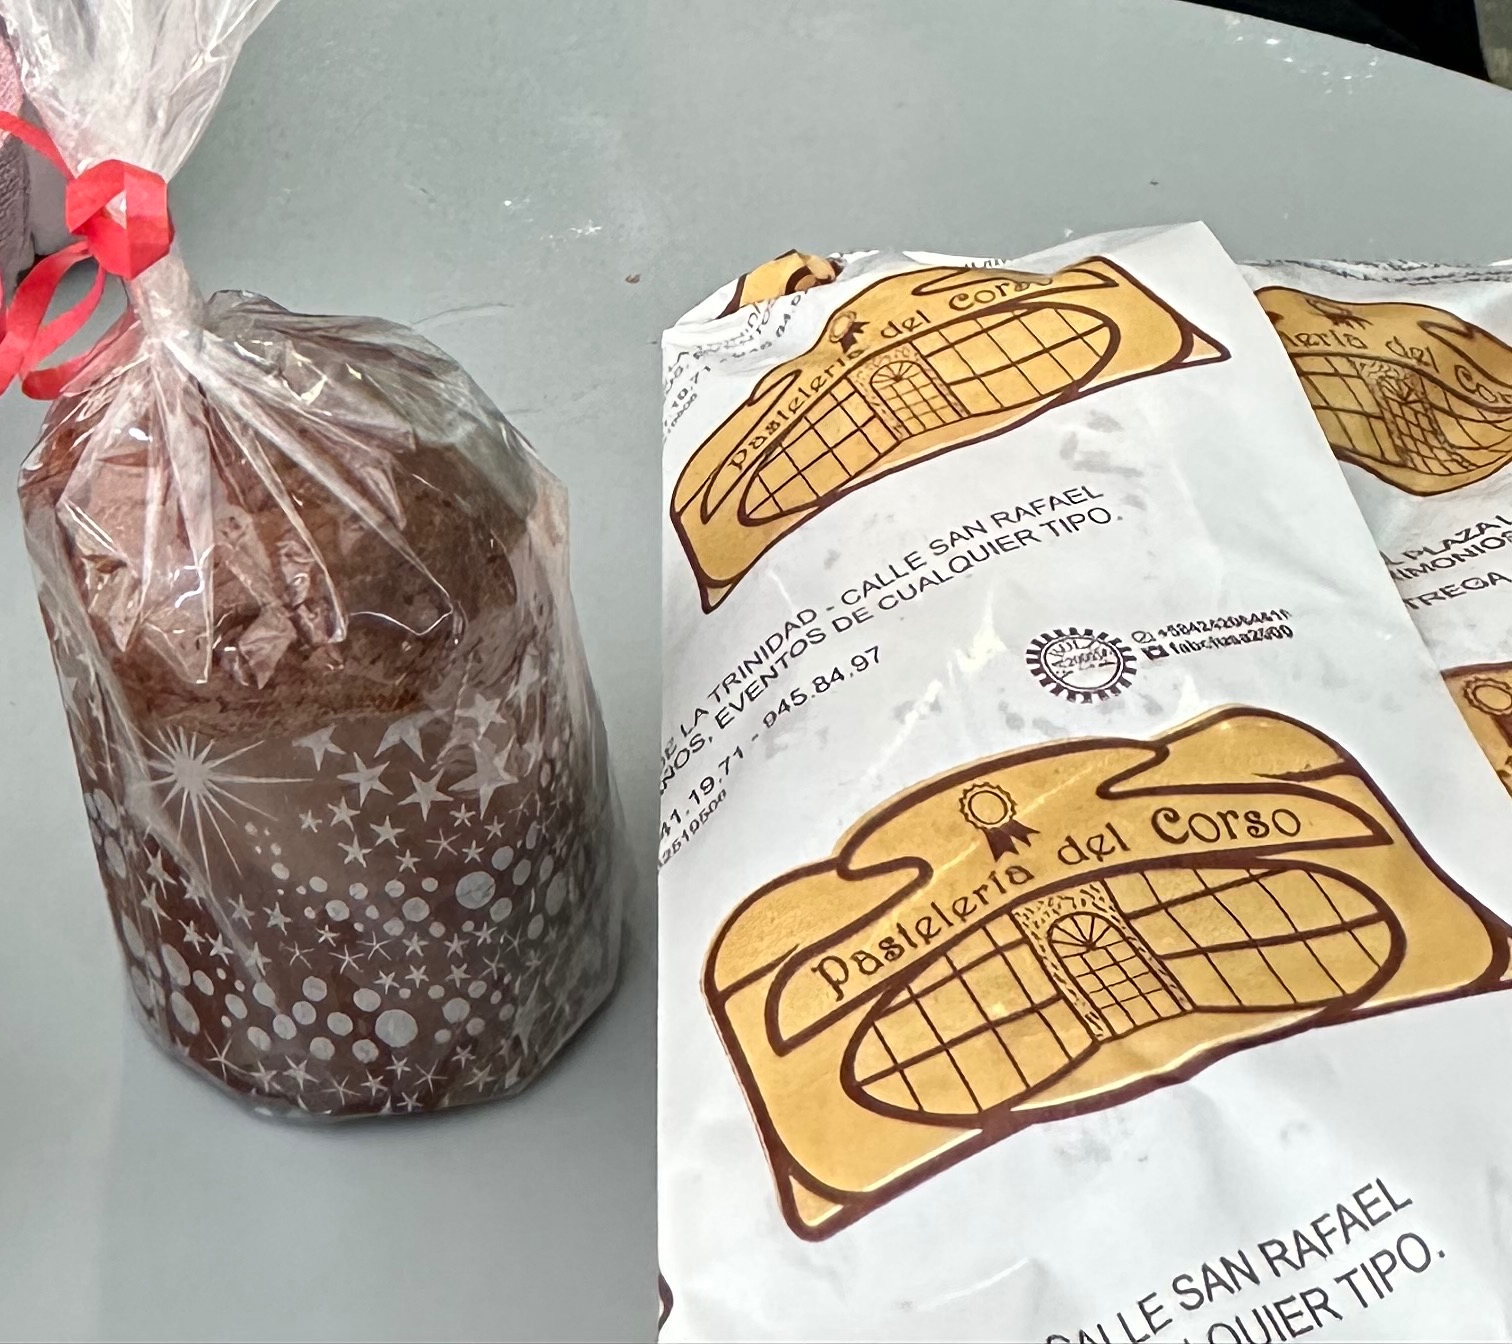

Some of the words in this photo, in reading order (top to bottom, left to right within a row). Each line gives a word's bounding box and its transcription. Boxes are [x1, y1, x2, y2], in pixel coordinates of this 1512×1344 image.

[880, 310, 932, 339] del
[1384, 335, 1440, 374] del
[680, 707, 710, 737] LA
[707, 608, 818, 703] TRINIDAD
[840, 550, 927, 607] CALLE
[928, 520, 987, 557] SAN
[990, 484, 1104, 533] RAFAEL
[714, 627, 827, 730] EVENTOS
[832, 606, 875, 633] DE
[878, 531, 1041, 610] CUALQUIER
[1040, 505, 1125, 540] TIPO.
[1056, 822, 1132, 868] del
[1150, 806, 1302, 845] Corso
[1171, 1249, 1261, 1311] SAN
[1257, 1177, 1414, 1279] RAFAEL
[1334, 1231, 1447, 1310] TIPO.
